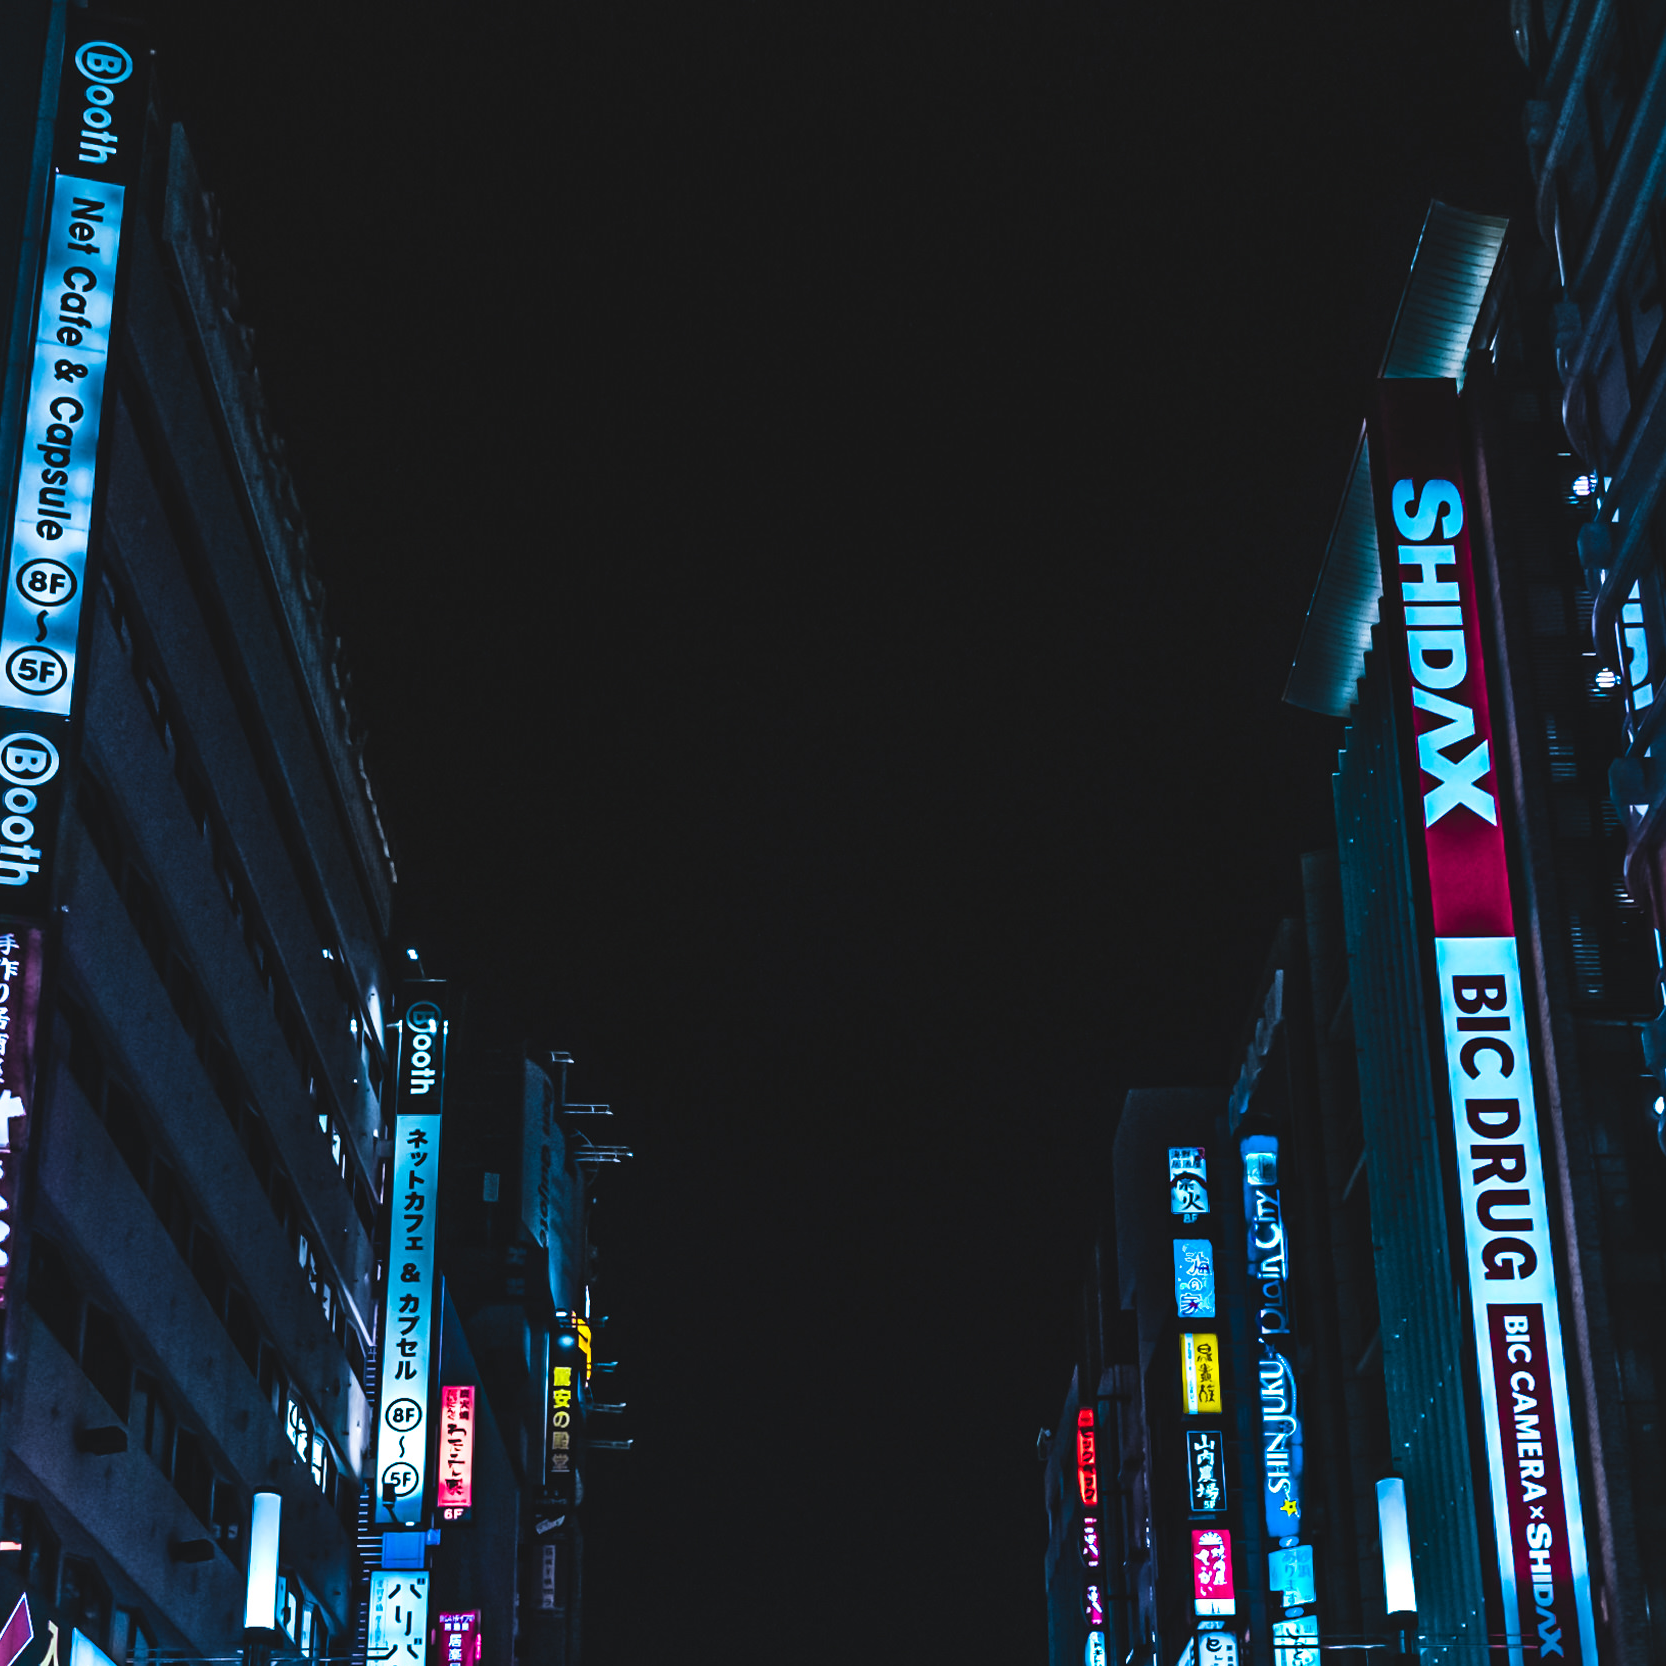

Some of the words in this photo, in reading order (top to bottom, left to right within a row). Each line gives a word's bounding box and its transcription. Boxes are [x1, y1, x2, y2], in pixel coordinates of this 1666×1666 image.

[75, 41, 132, 165] Booth
[64, 197, 105, 255] Net
[57, 266, 97, 347] Cafe
[54, 359, 88, 382] &
[36, 396, 84, 542] Capsule
[1391, 478, 1498, 829] SHIDAX
[406, 1001, 443, 1096] Booth
[1450, 973, 1516, 1081] BIC
[403, 1128, 429, 1252] ネットカフェ
[1464, 1097, 1539, 1283] DRUG
[400, 1263, 421, 1283] &
[1179, 1251, 1211, 1317] 海の家
[394, 1293, 420, 1381] カプセル
[1502, 1314, 1532, 1365] BIC
[1259, 1361, 1298, 1494] SHINJUKU
